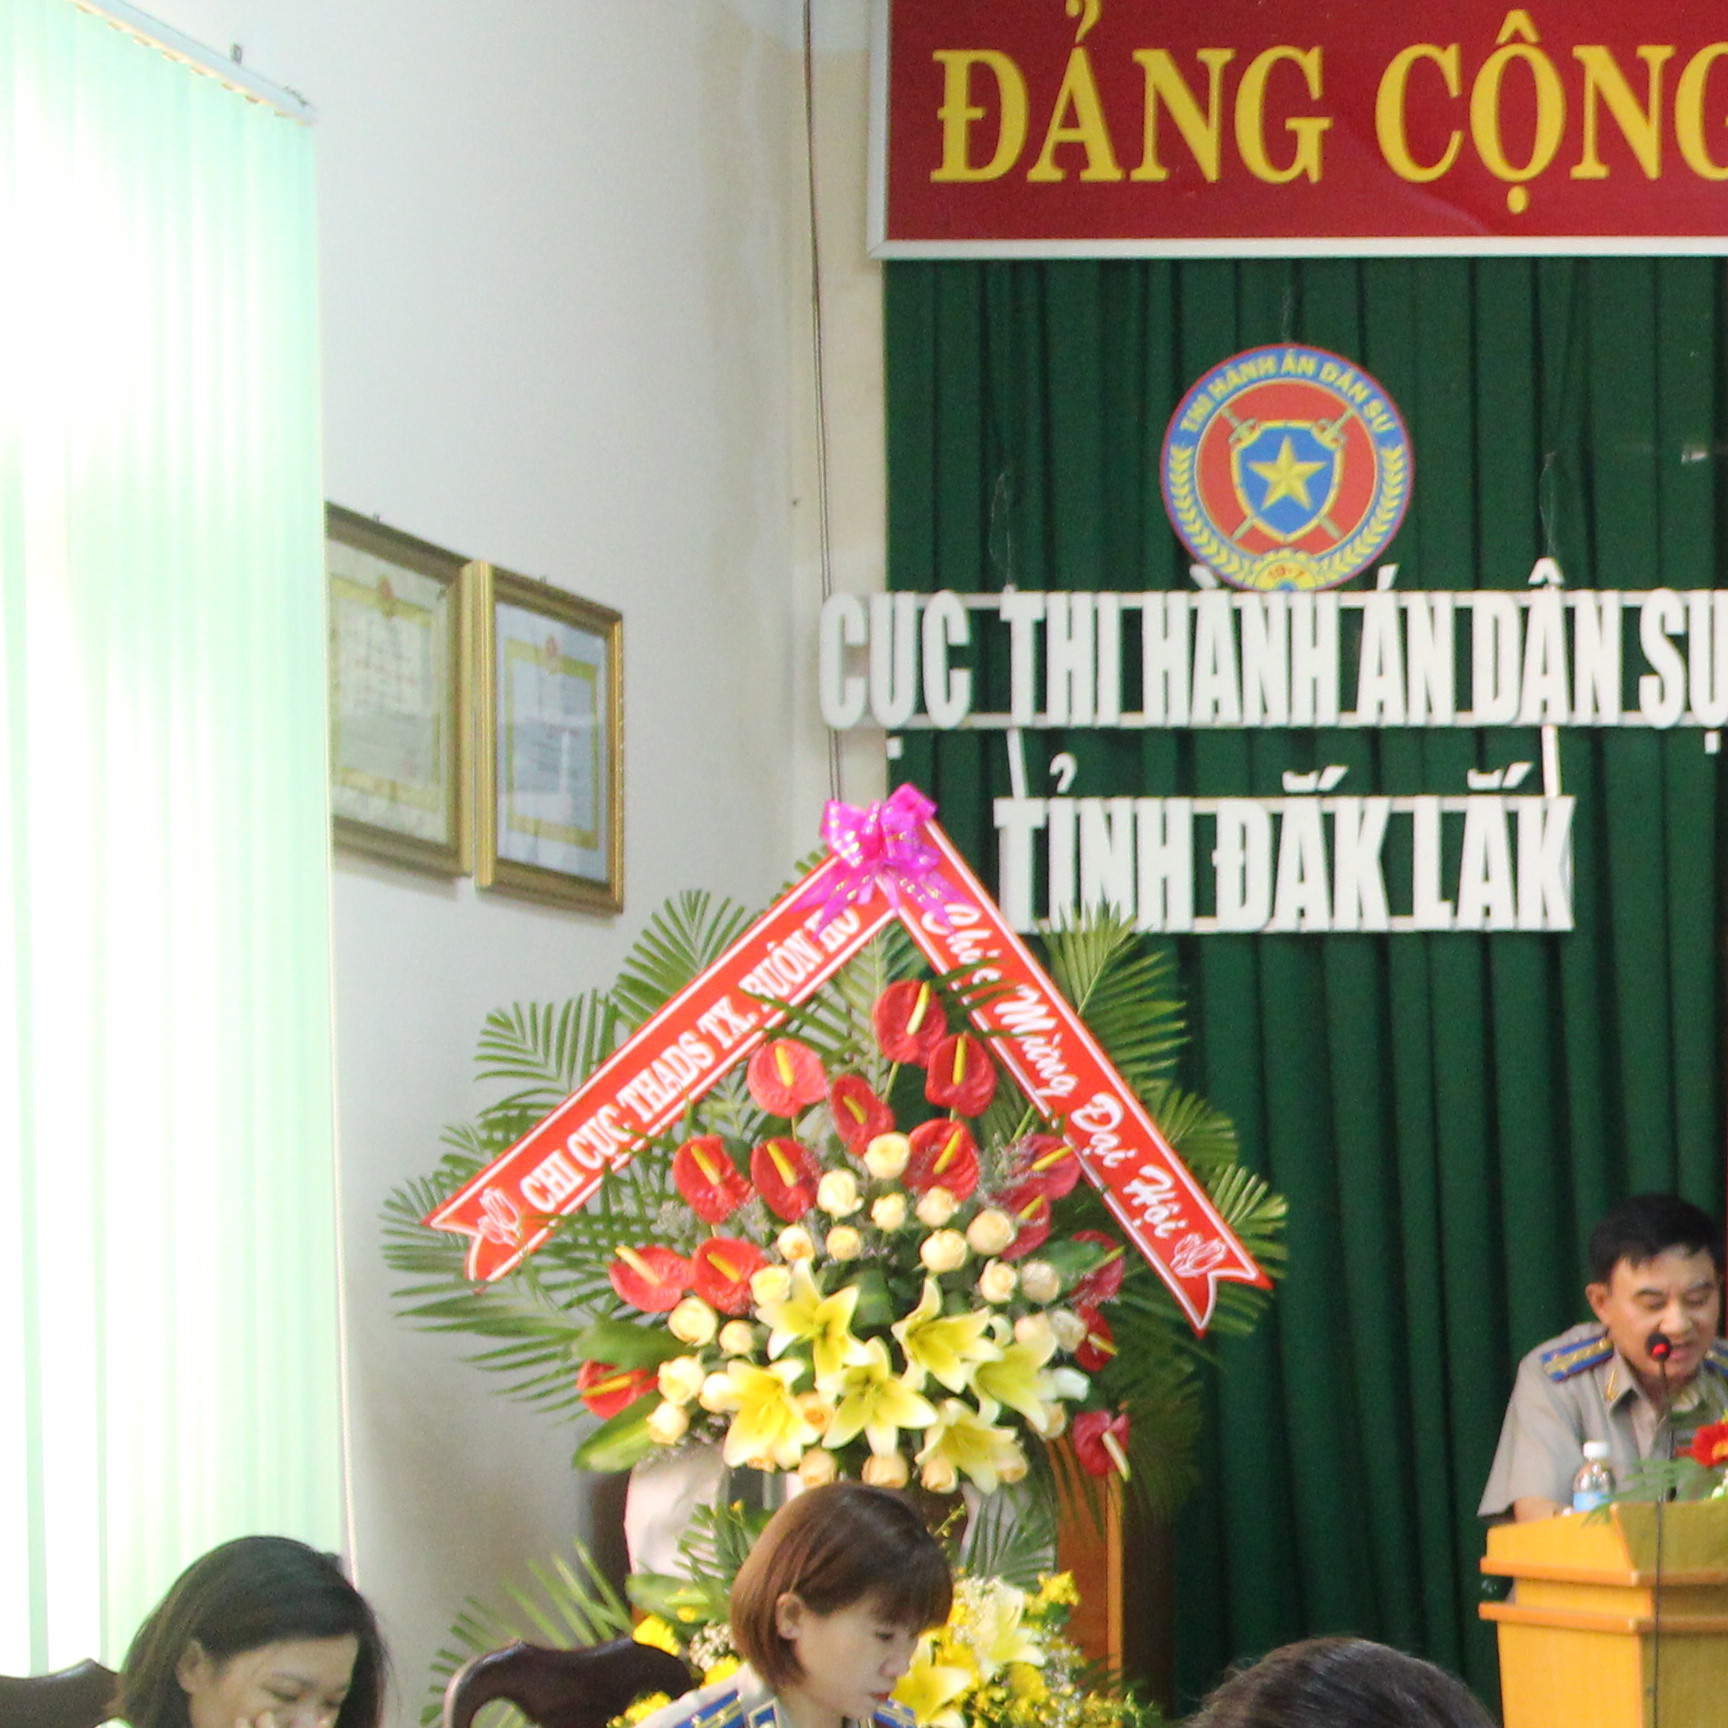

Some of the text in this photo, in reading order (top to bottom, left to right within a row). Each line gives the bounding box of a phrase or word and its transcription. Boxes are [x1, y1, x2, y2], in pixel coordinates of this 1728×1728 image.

[931, 0, 1331, 183] ĐẢNG
[1180, 393, 1216, 433] THI
[819, 590, 972, 757] CỤC
[999, 590, 1121, 727] THI
[1142, 563, 1343, 727] HÀNH
[1355, 564, 1455, 727] ÁN
[1470, 557, 1620, 727] DÂN
[995, 753, 1575, 934] TỈNH ĐẮK LẮK
[519, 1149, 586, 1212] CHI
[616, 1030, 716, 1123] THADS
[1070, 1092, 1138, 1168] Đại
[1122, 1164, 1189, 1238] Hội
